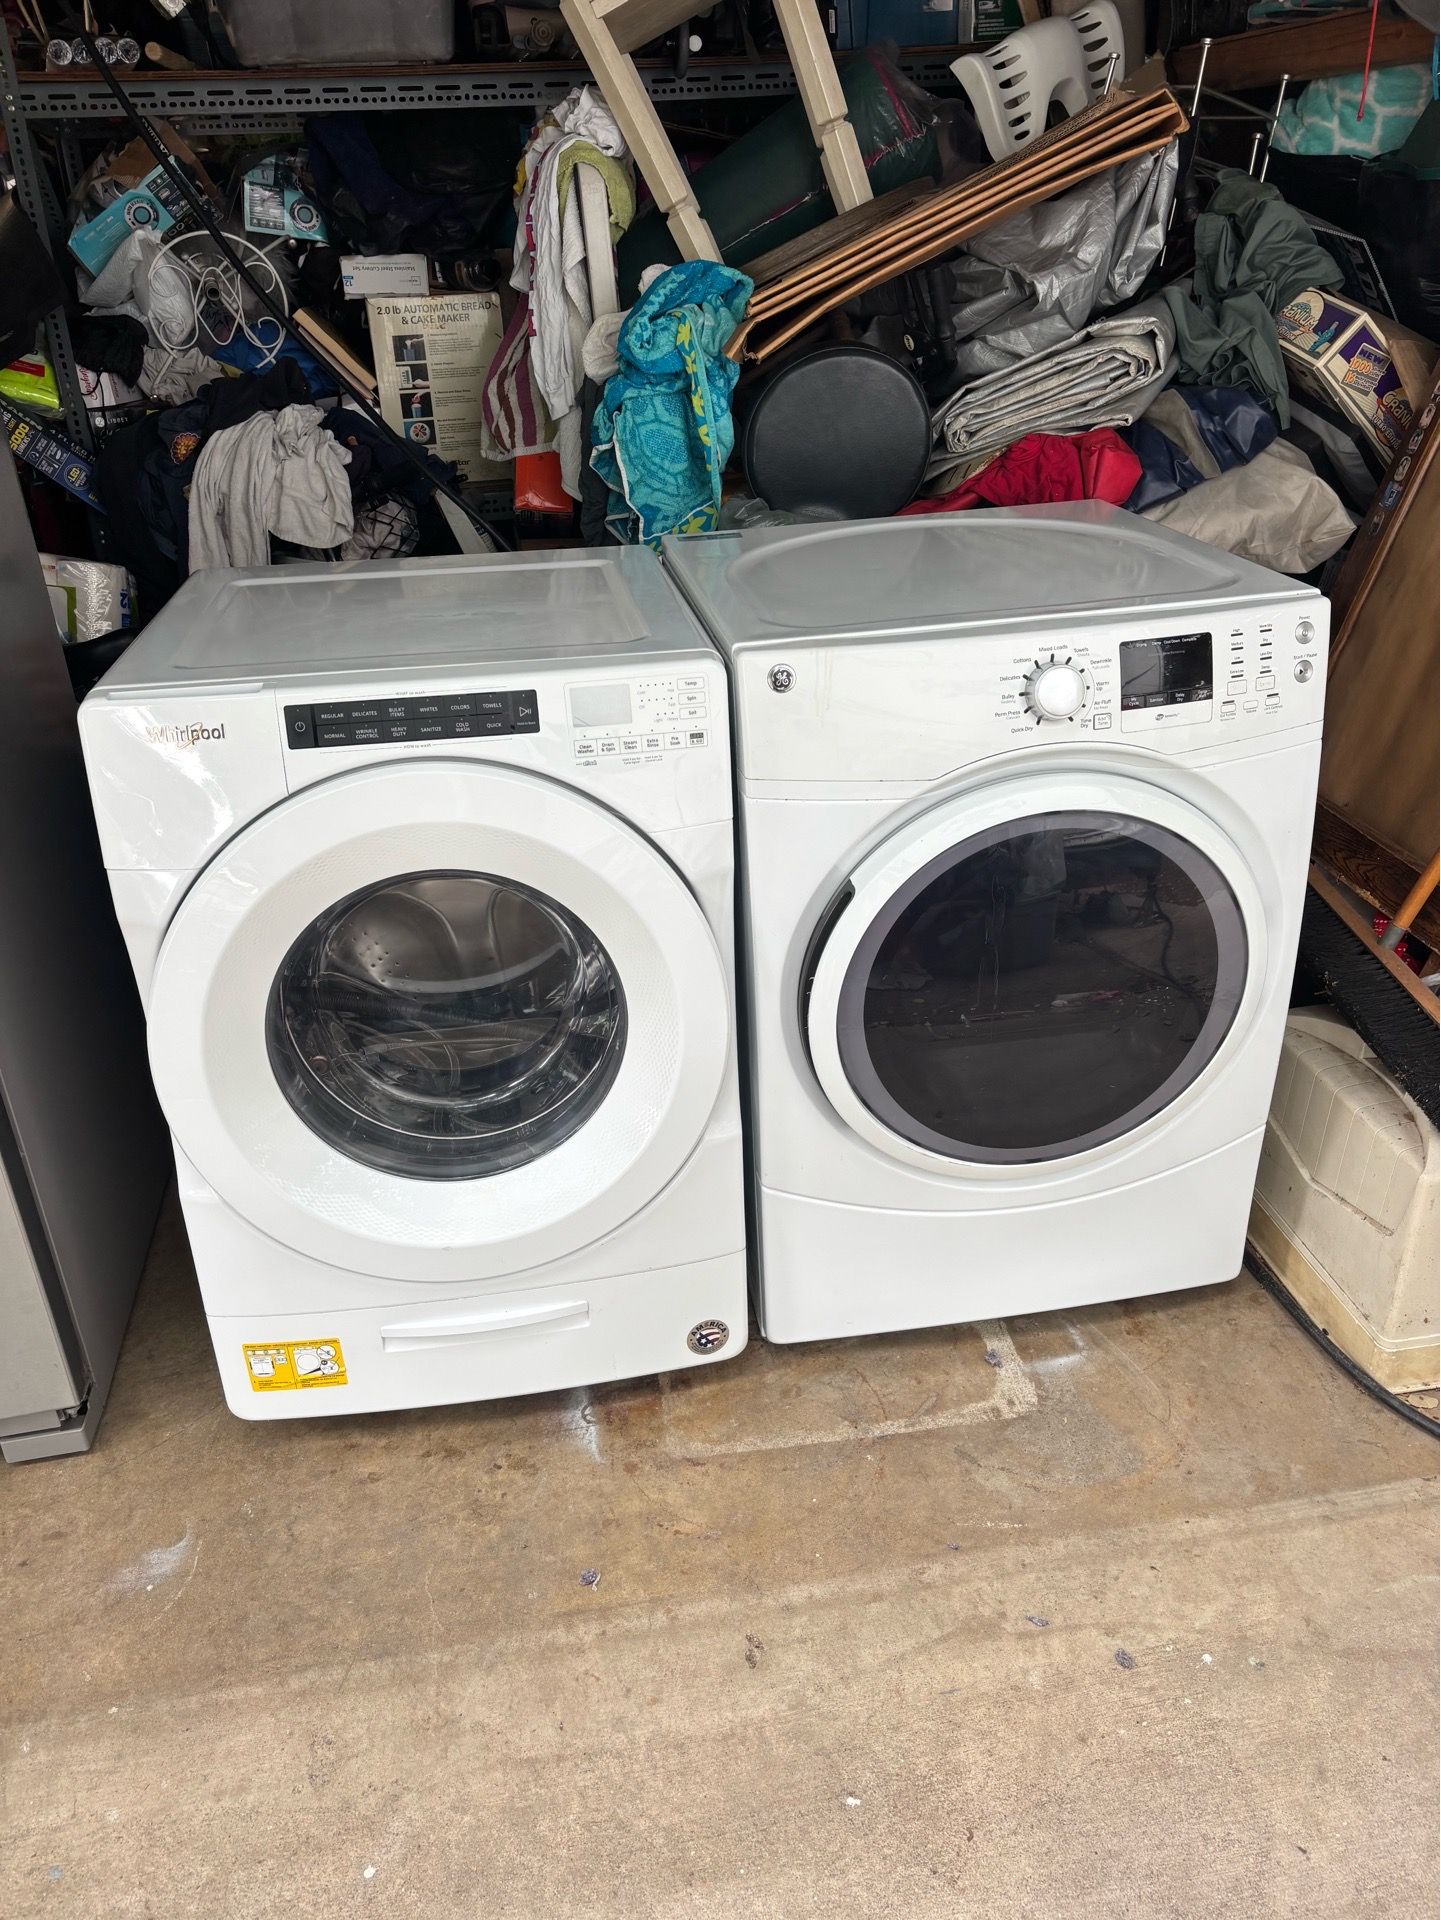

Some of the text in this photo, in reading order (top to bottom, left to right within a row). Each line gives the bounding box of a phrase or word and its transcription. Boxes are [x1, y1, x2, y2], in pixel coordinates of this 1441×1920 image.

[377, 301, 492, 315] 2.0 lb AUTOMATIC BREAD
[401, 313, 471, 325] & CAKE MAKER
[1356, 349, 1385, 365] NEW
[1350, 357, 1373, 375] 1000
[1372, 414, 1386, 434] TURBO
[145, 723, 225, 746] Whirlpool
[691, 1321, 727, 1337] AMERICA
